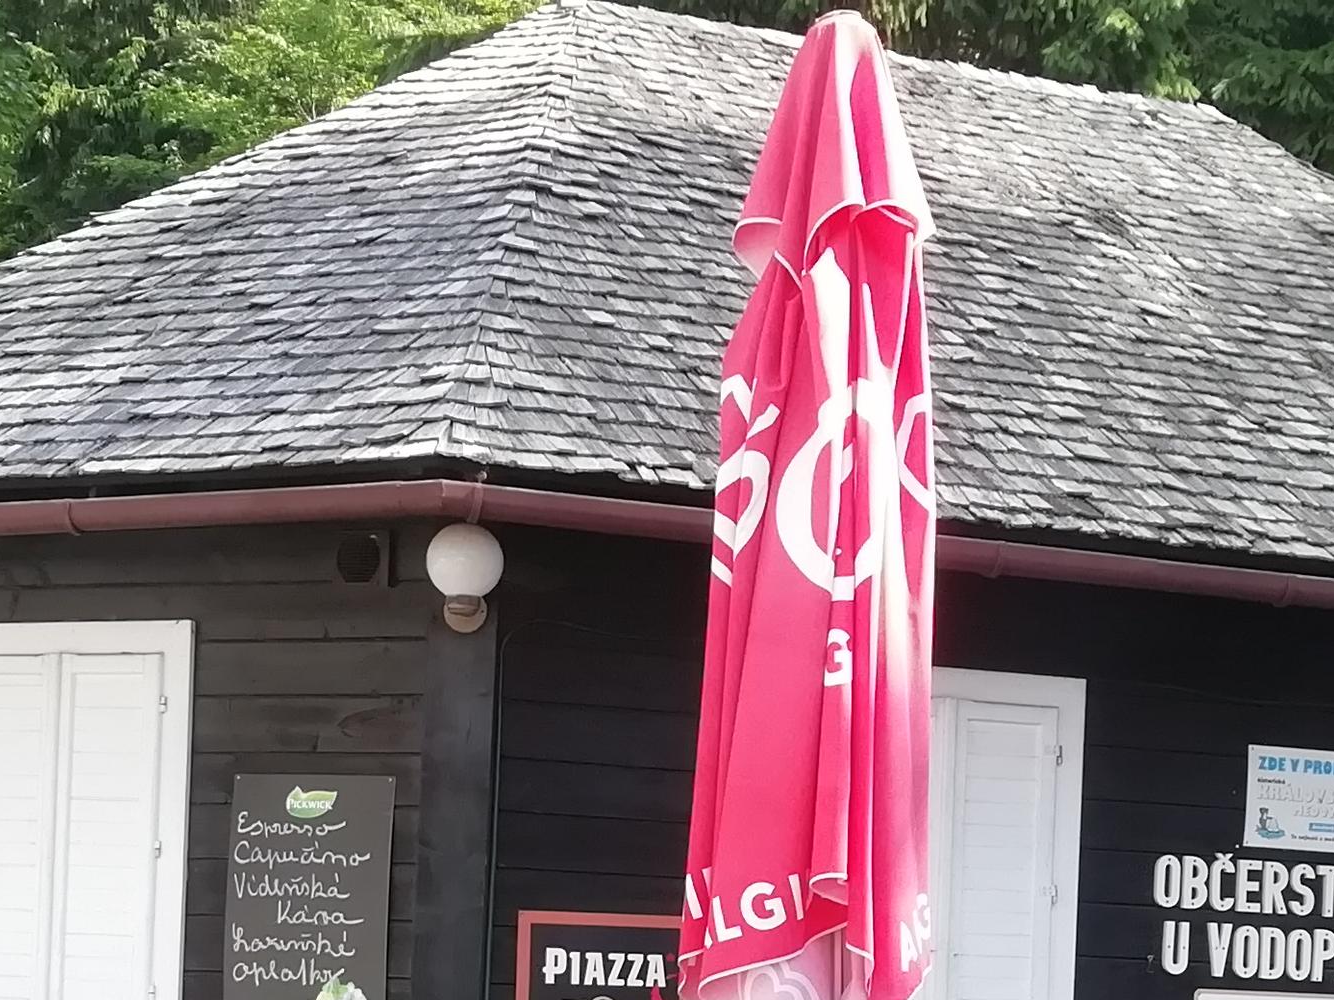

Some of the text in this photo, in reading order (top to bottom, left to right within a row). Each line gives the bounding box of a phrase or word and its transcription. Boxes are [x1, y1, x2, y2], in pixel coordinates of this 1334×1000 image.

[1258, 756, 1286, 771] ZDE
[1290, 759, 1300, 772] V
[542, 947, 666, 988] PIAZZA
[1161, 920, 1190, 975] U
